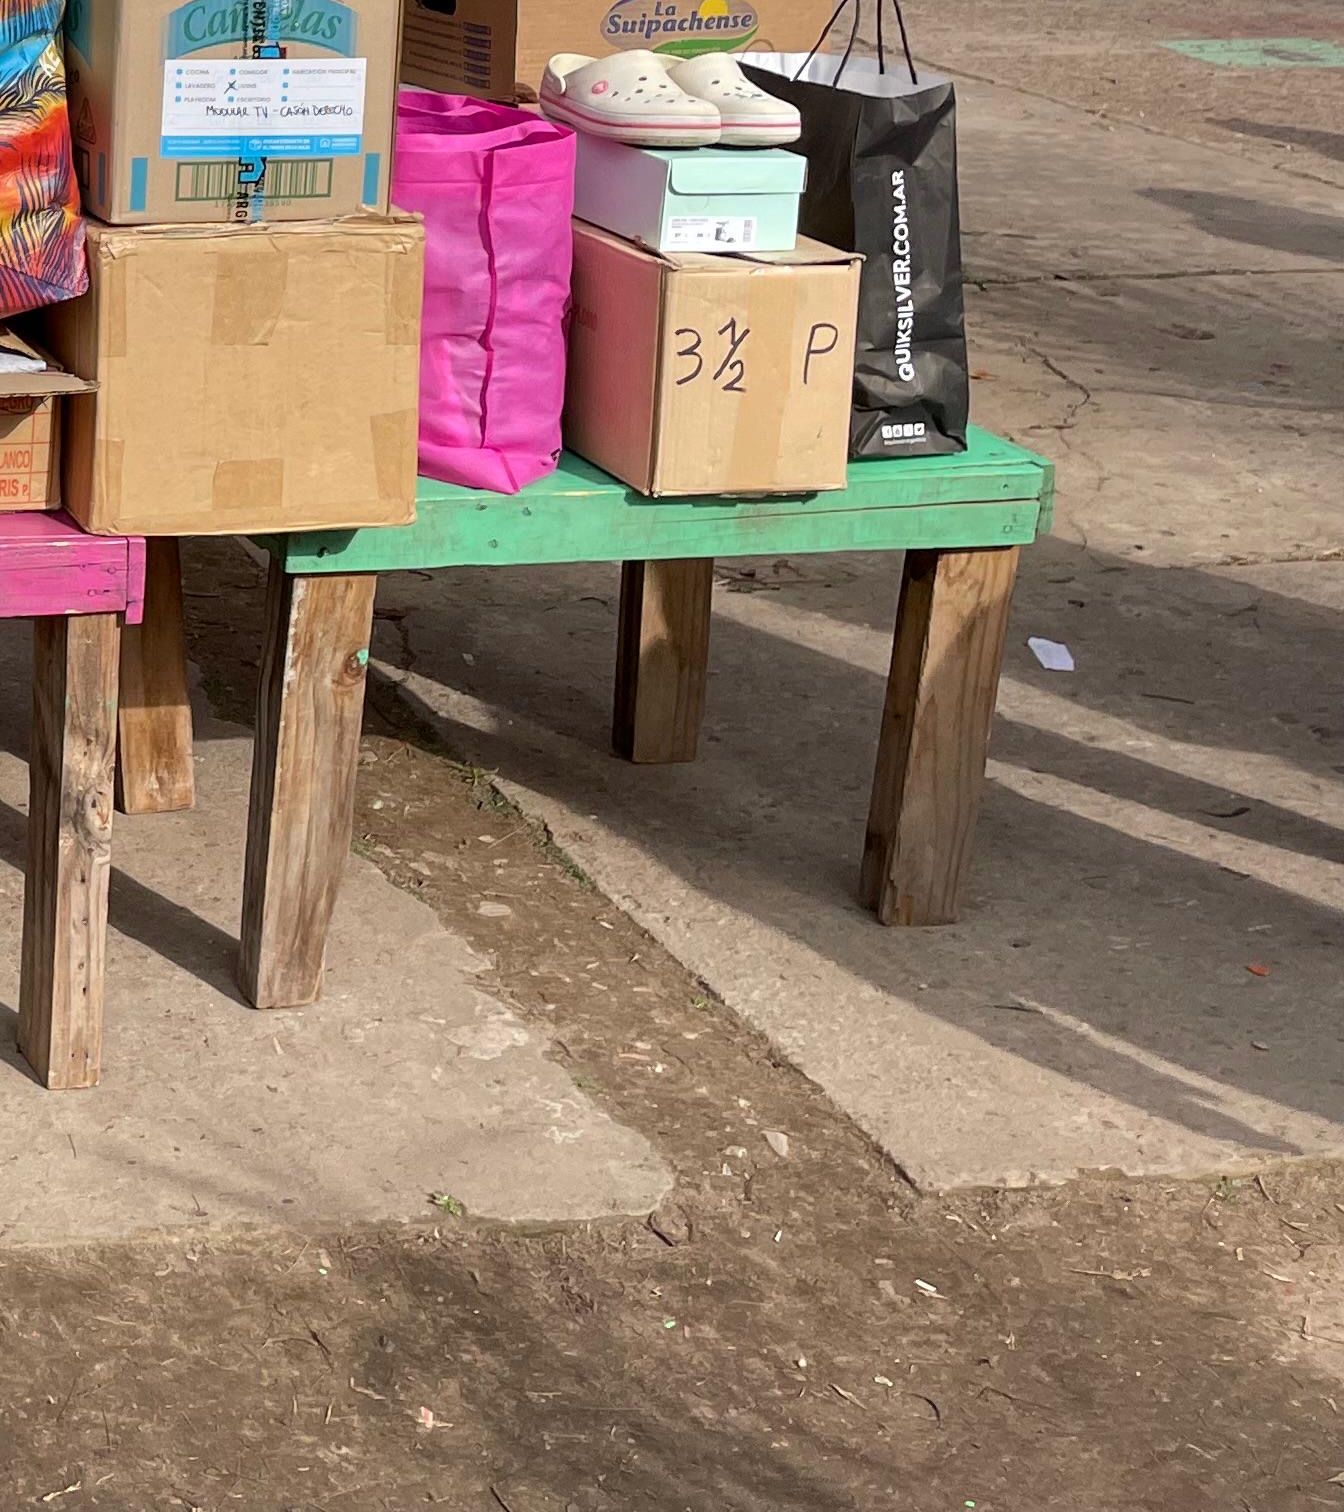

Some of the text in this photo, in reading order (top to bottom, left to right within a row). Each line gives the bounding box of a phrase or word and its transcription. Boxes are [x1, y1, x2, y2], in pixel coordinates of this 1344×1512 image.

[654, 1, 676, 16] La
[607, 11, 752, 39] Suipachense
[255, 106, 268, 118] TV
[891, 169, 915, 382] QUIKSILVER.COM.AR
[674, 328, 703, 385] 3
[803, 323, 838, 385] P
